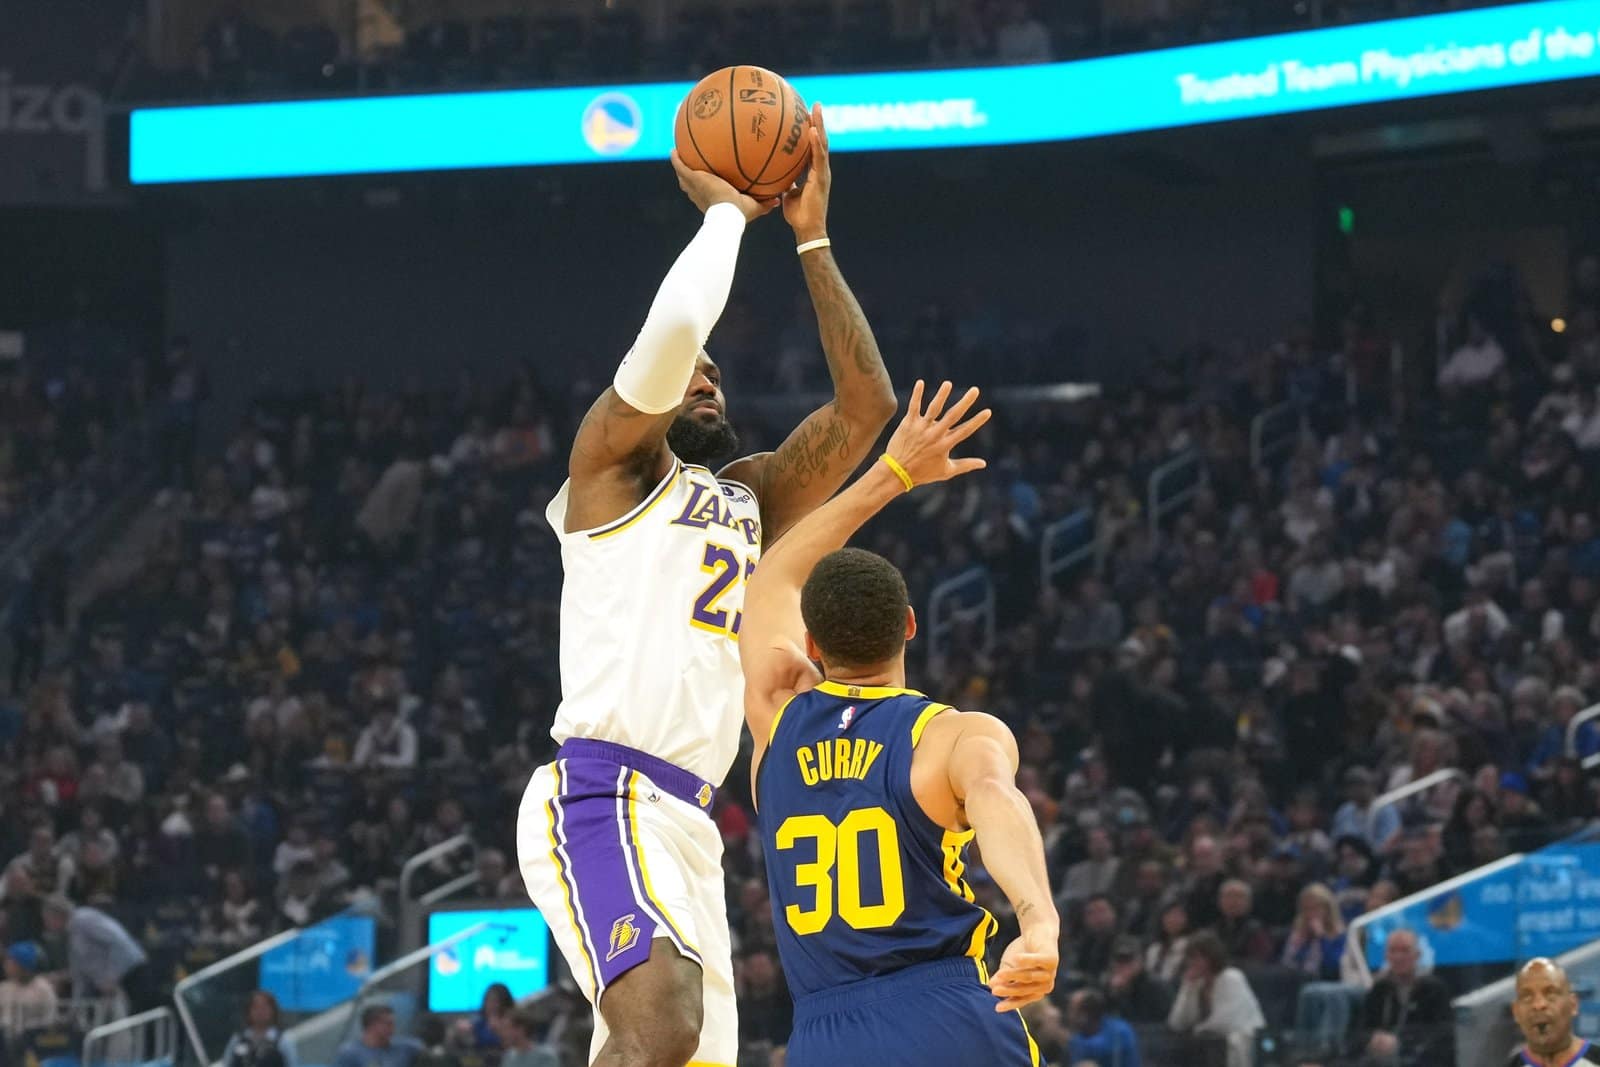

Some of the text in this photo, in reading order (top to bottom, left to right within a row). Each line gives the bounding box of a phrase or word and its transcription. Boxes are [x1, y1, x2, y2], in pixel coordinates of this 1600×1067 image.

[1177, 26, 1596, 104] Trusted Team Physicians of the
[796, 738, 885, 787] CURRY
[775, 806, 906, 936] 30
